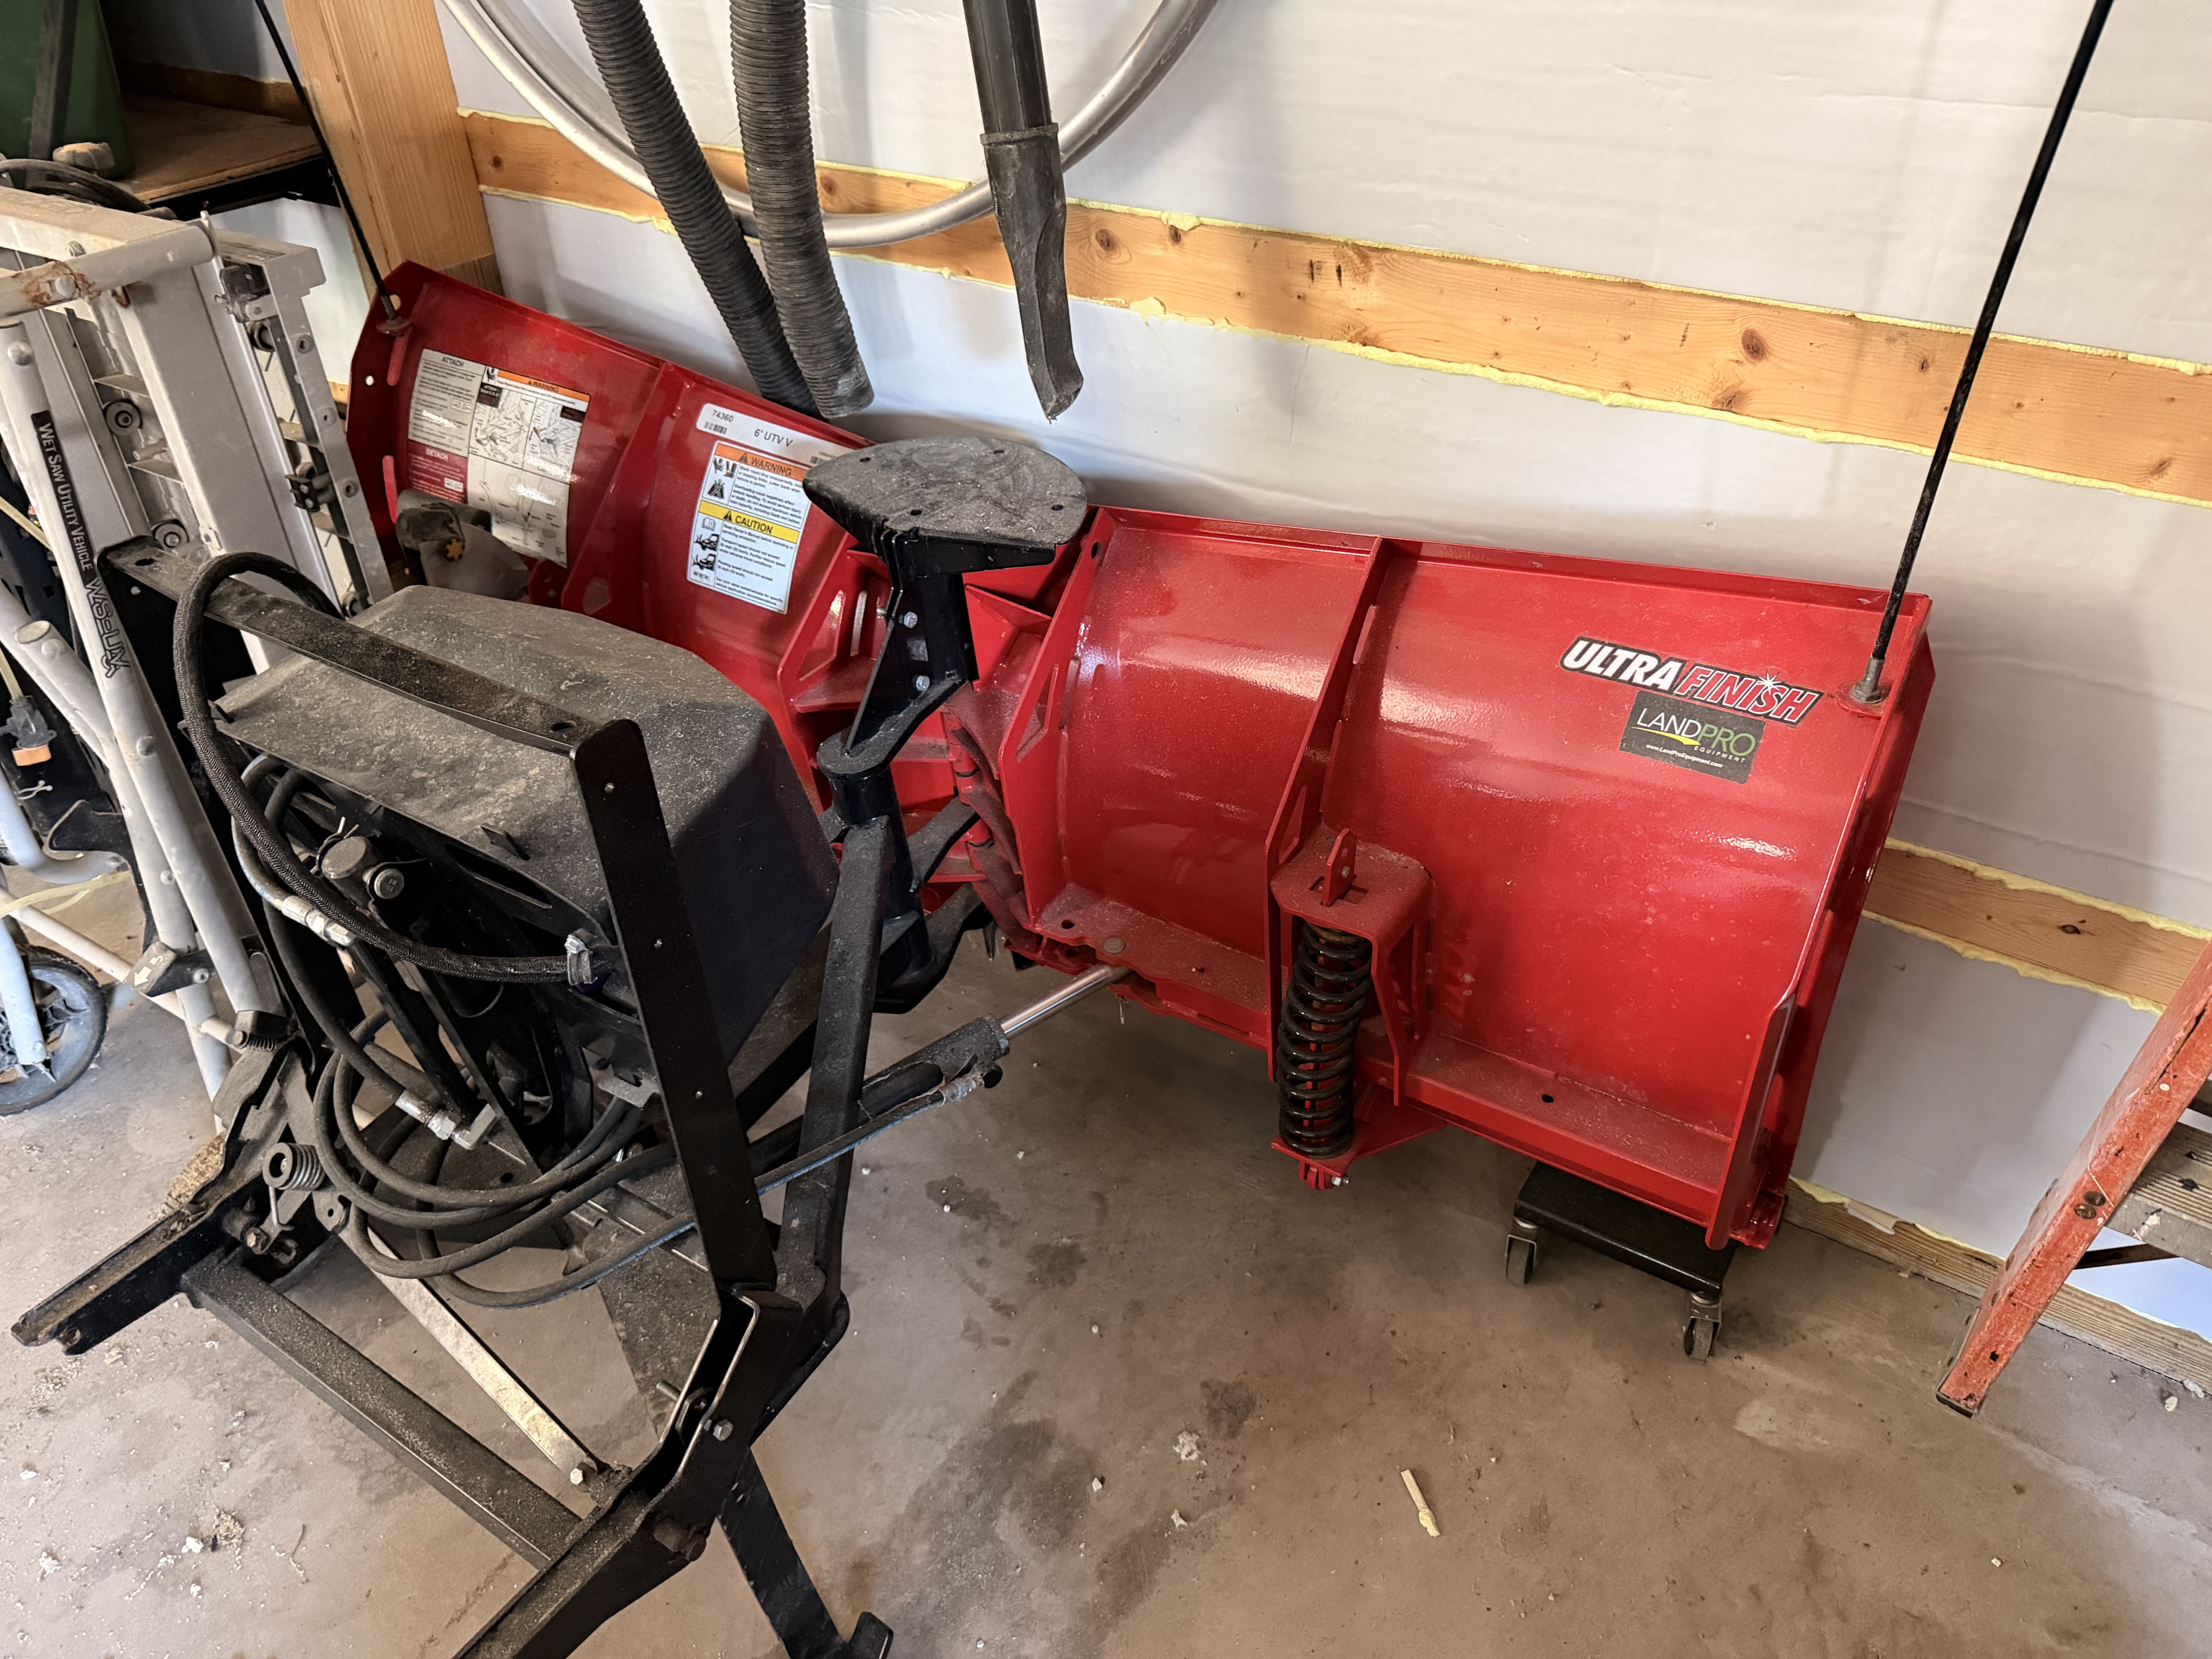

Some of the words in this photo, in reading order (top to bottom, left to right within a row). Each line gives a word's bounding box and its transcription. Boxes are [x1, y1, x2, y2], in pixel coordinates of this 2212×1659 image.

[442, 356, 464, 368] ATTACH
[532, 380, 560, 393] WARNING
[712, 410, 734, 422] 74360
[754, 428, 763, 438] 6'
[764, 431, 783, 445] UTV
[784, 438, 793, 447] V
[426, 448, 448, 461] DETACH
[751, 457, 793, 477] WARNING
[39, 422, 57, 452] WET
[48, 454, 66, 482] SAW
[58, 483, 79, 527] UTILITY
[72, 527, 93, 571] VEHICLE
[735, 514, 773, 534] CAUTION
[1562, 639, 1685, 692] ULTRA
[1673, 665, 1819, 723] FINISH
[1636, 708, 1756, 757] LANDPRO
[1645, 744, 1723, 768] www.LandProEquipment.com
[1694, 745, 1745, 763] EQUIPMENT
